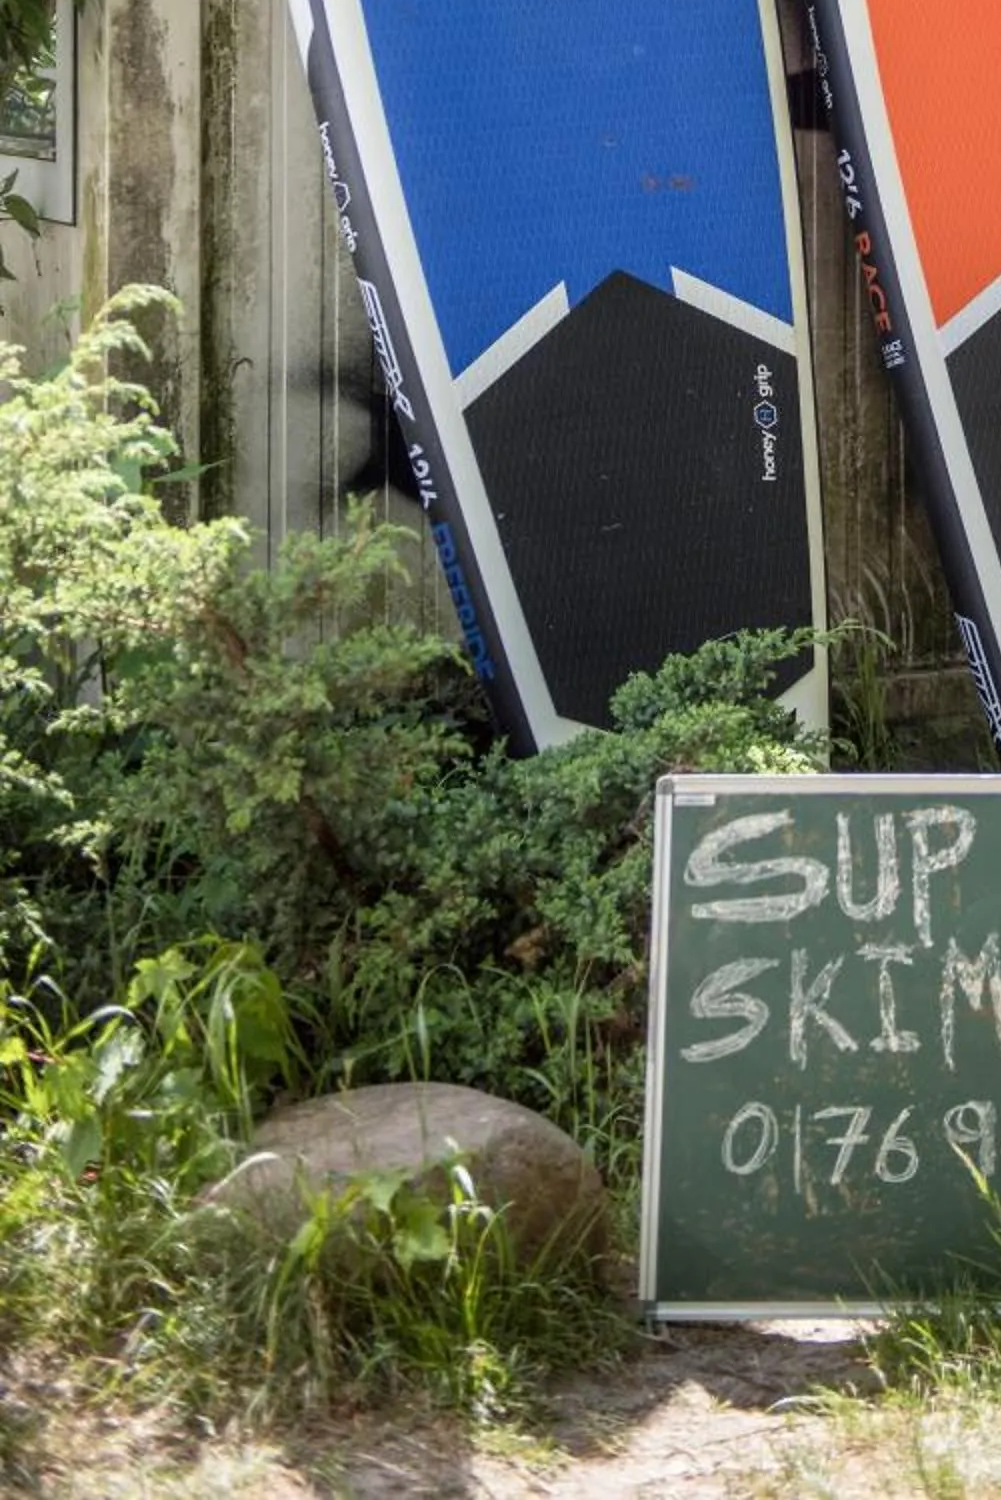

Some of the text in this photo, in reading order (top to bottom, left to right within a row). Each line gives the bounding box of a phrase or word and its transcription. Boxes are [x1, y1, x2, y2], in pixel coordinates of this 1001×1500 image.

[855, 231, 892, 333] RACE
[754, 363, 773, 397] grip
[761, 430, 777, 481] honey
[684, 805, 977, 948] SUP
